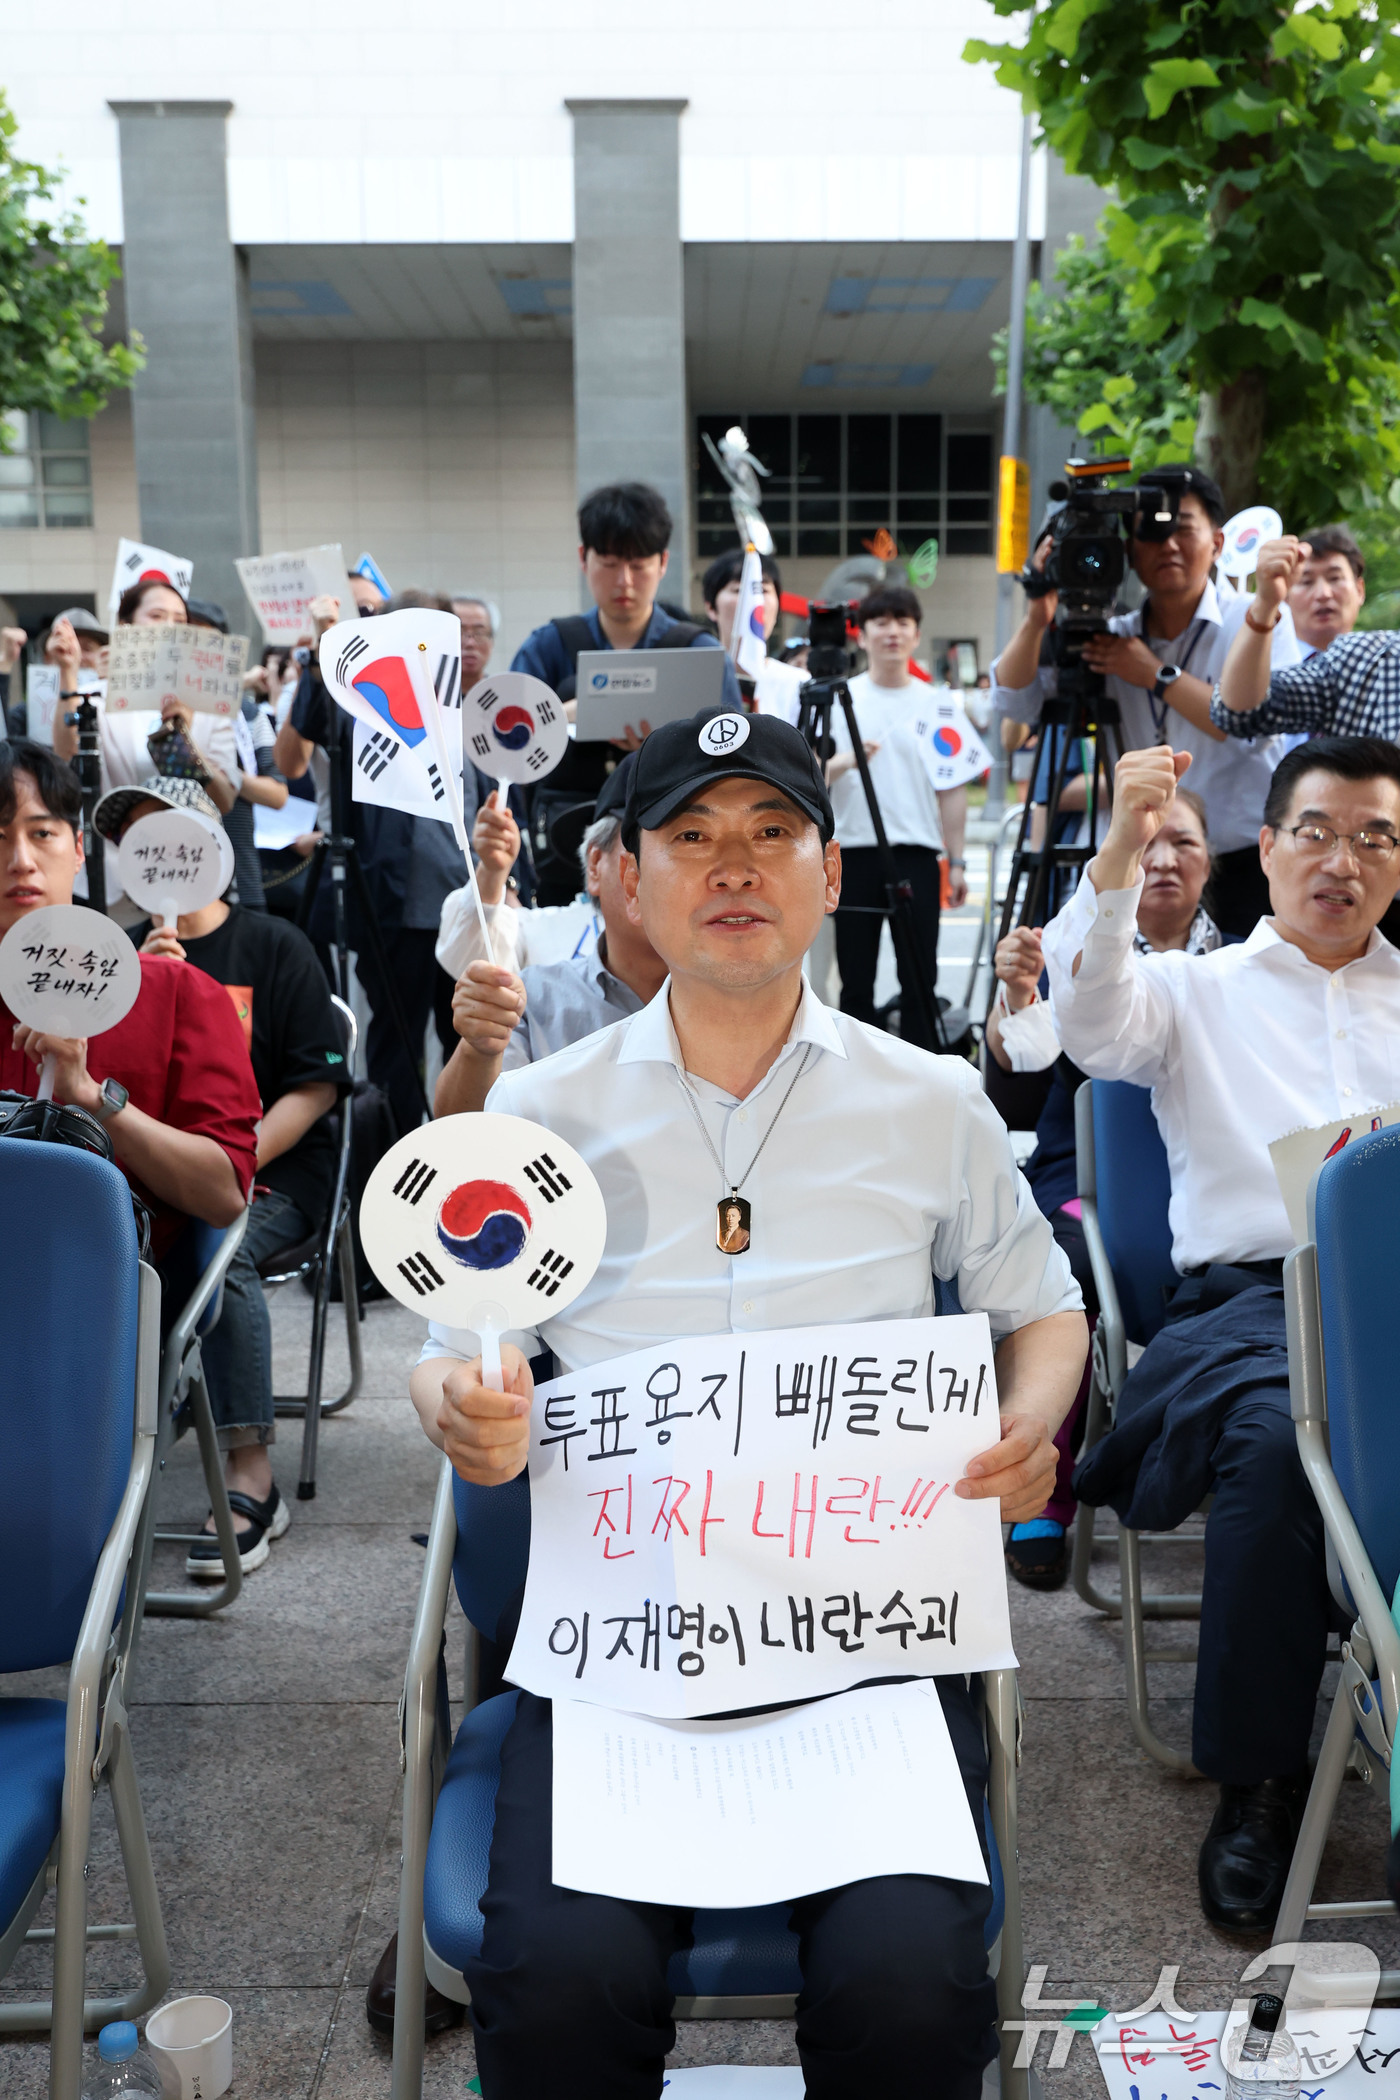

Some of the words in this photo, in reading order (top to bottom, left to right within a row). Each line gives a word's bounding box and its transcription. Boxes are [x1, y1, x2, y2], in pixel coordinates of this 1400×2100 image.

[713, 742, 735, 752] 0603
[142, 867, 200, 884] 끝내자!
[27, 972, 108, 1001] 끝내자!
[540, 1350, 747, 1471] 투표용지
[775, 1350, 989, 1449] 빼돌린게
[587, 1469, 725, 1560] 진짜
[752, 1471, 950, 1559] 내란!!!
[548, 1598, 746, 1679] 이재명이
[760, 1590, 959, 1655] 내란수괴
